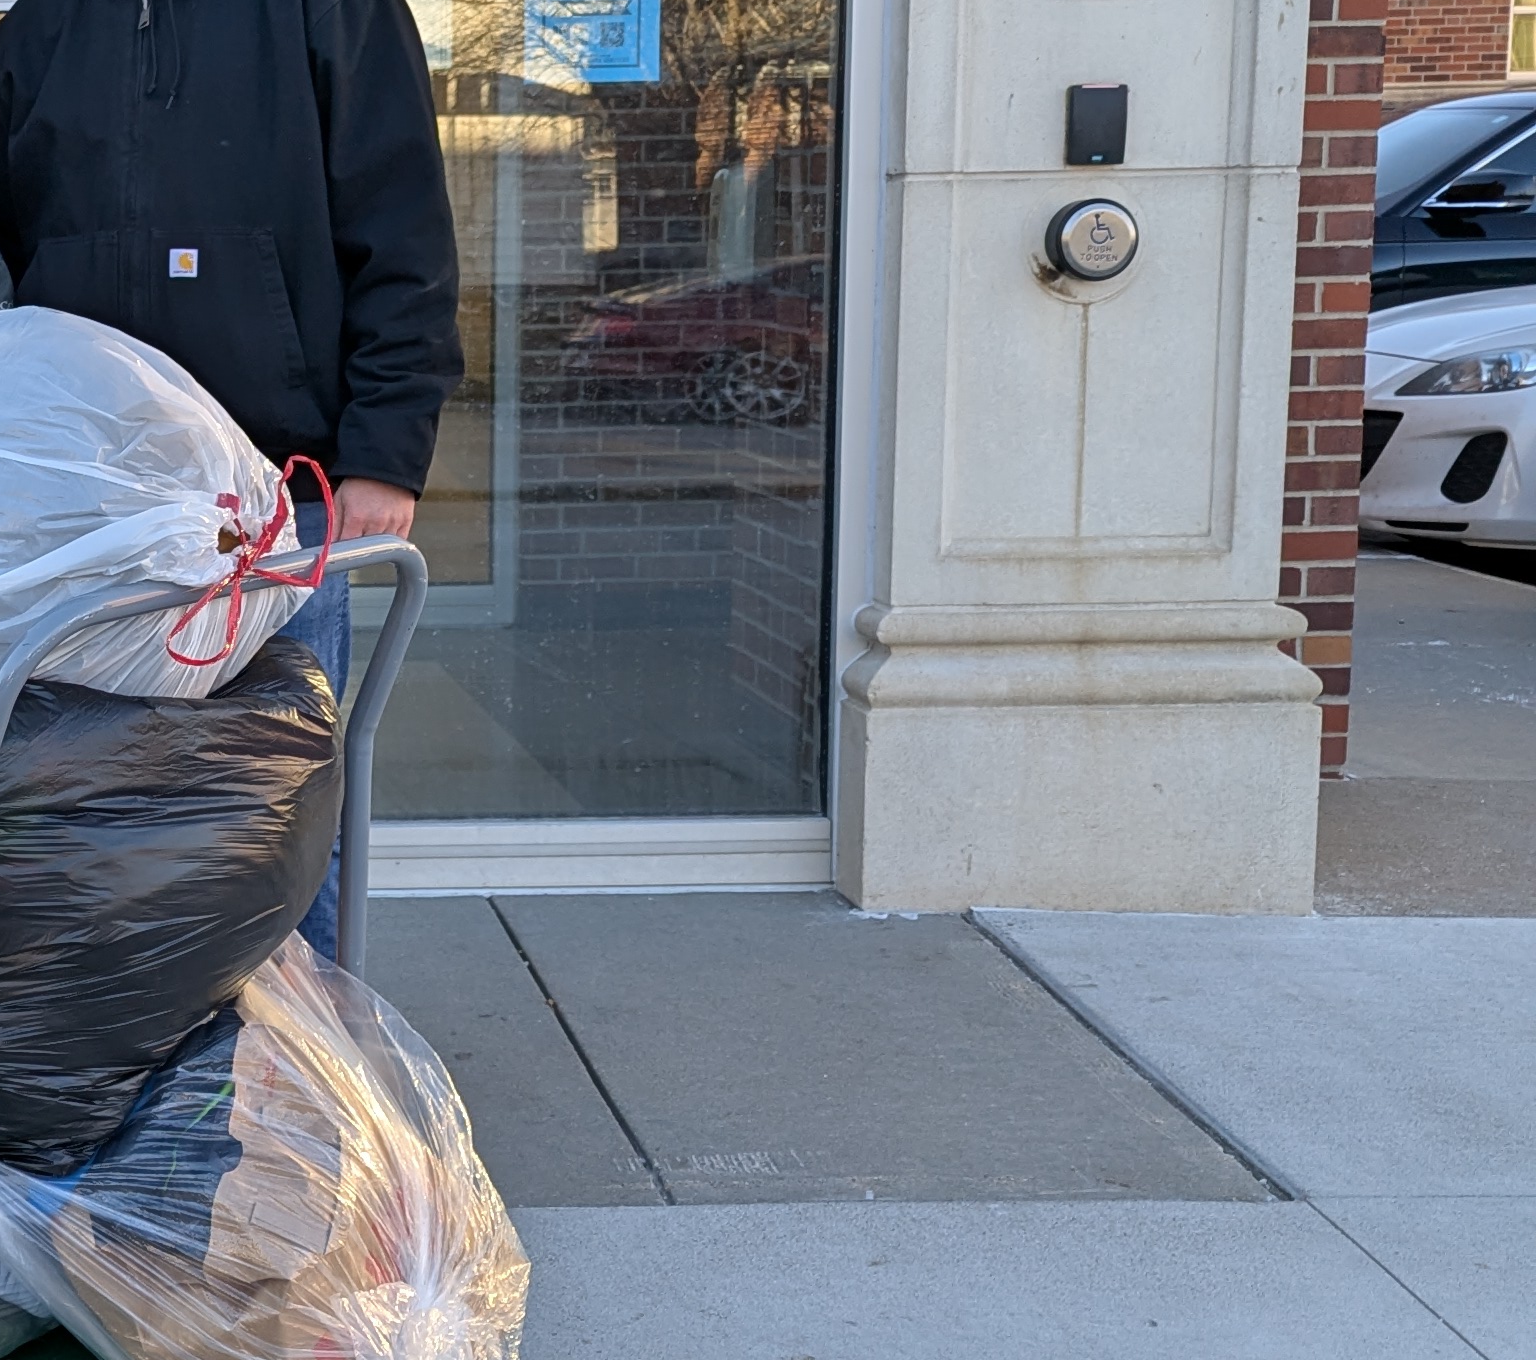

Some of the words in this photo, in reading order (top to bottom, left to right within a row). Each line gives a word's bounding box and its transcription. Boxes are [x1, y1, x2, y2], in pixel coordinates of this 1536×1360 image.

[1087, 245, 1113, 253] PUSH
[1080, 253, 1092, 261] TO
[1093, 253, 1118, 261] OPEN
